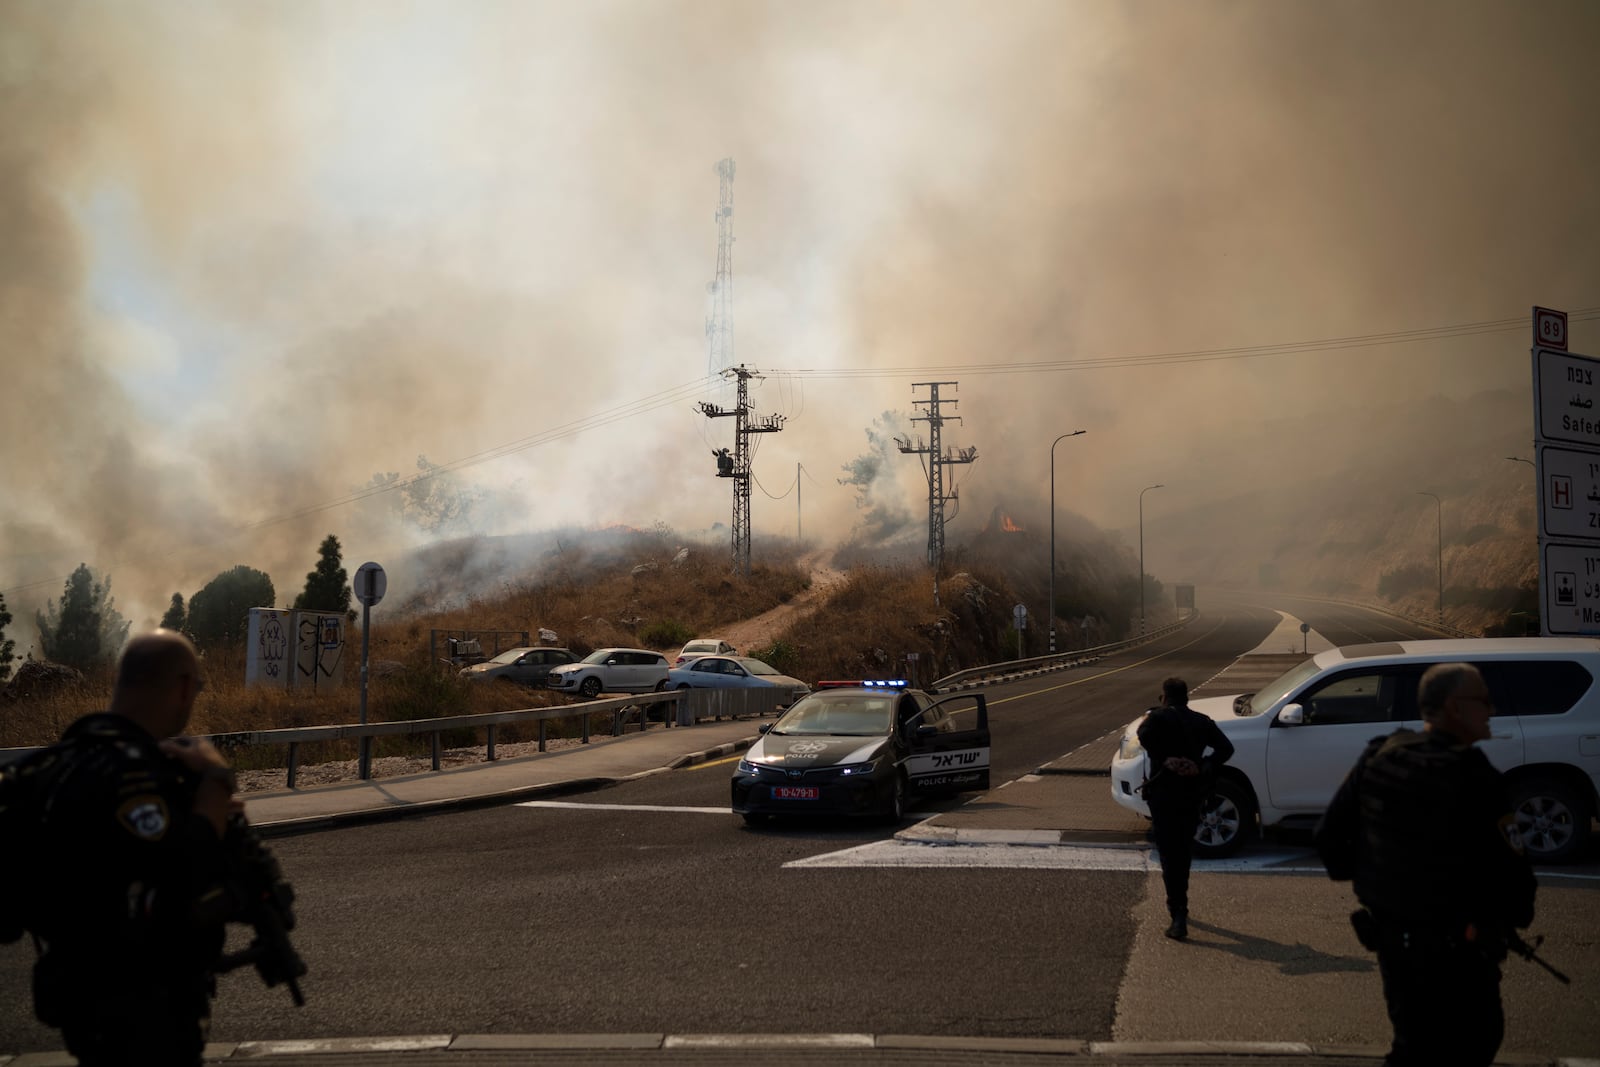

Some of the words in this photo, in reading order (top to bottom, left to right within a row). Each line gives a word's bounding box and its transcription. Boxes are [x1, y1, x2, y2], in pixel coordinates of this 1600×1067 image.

[1544, 320, 1560, 337] 89
[1567, 366, 1593, 386] צפת
[931, 751, 981, 767] ישראל
[917, 776, 947, 787] POLICE
